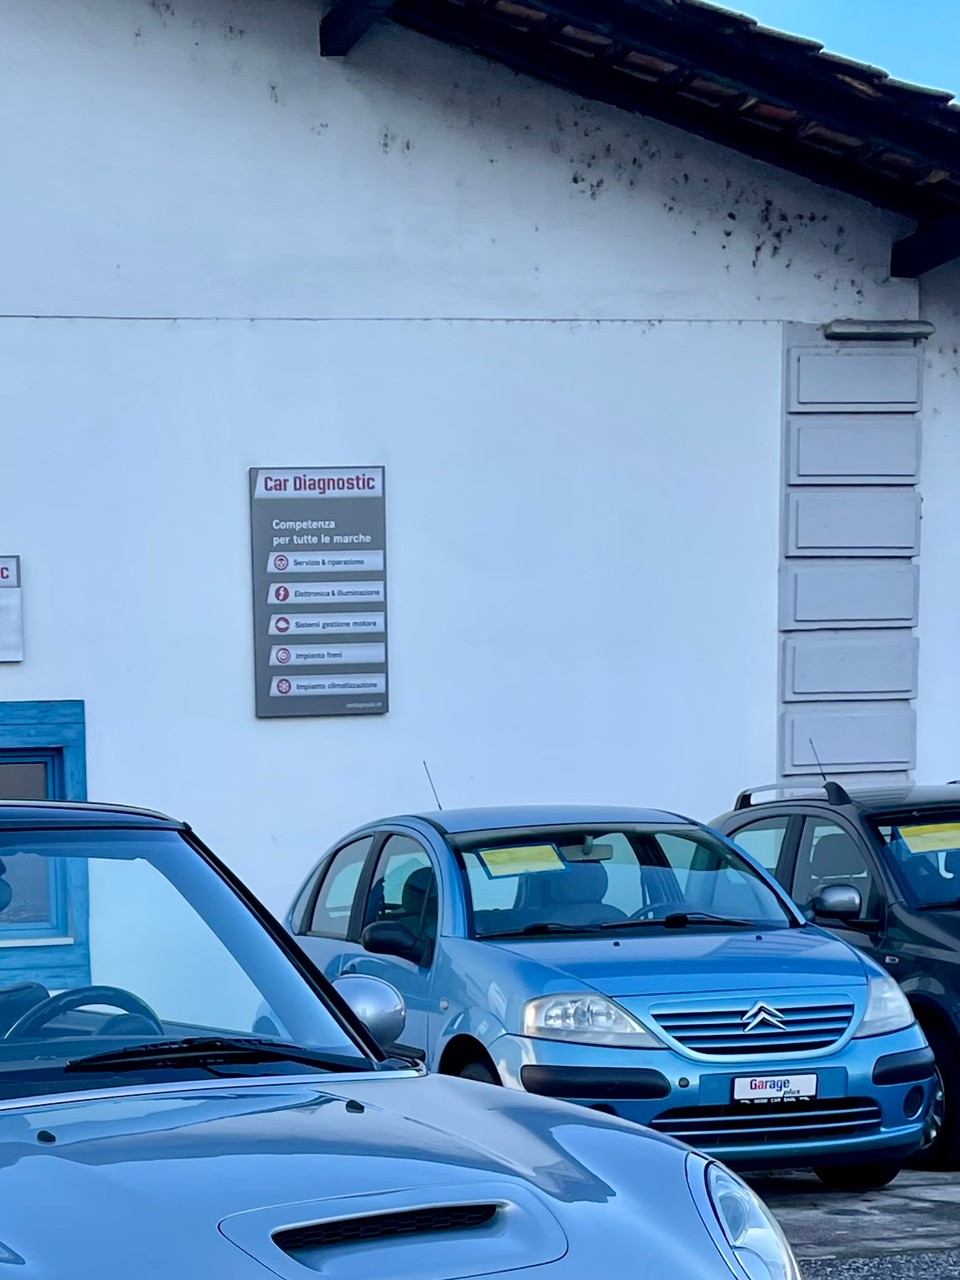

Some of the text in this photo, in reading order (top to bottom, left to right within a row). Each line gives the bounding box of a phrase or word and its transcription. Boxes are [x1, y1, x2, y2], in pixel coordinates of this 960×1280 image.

[264, 473, 375, 494] Car Diagnostic
[272, 519, 336, 531] Competenza
[273, 533, 372, 547] per tutte le marche
[293, 558, 320, 567] Servizio
[295, 621, 320, 629] Sistemi
[322, 620, 350, 630] gestione
[749, 1078, 790, 1092] Garage
